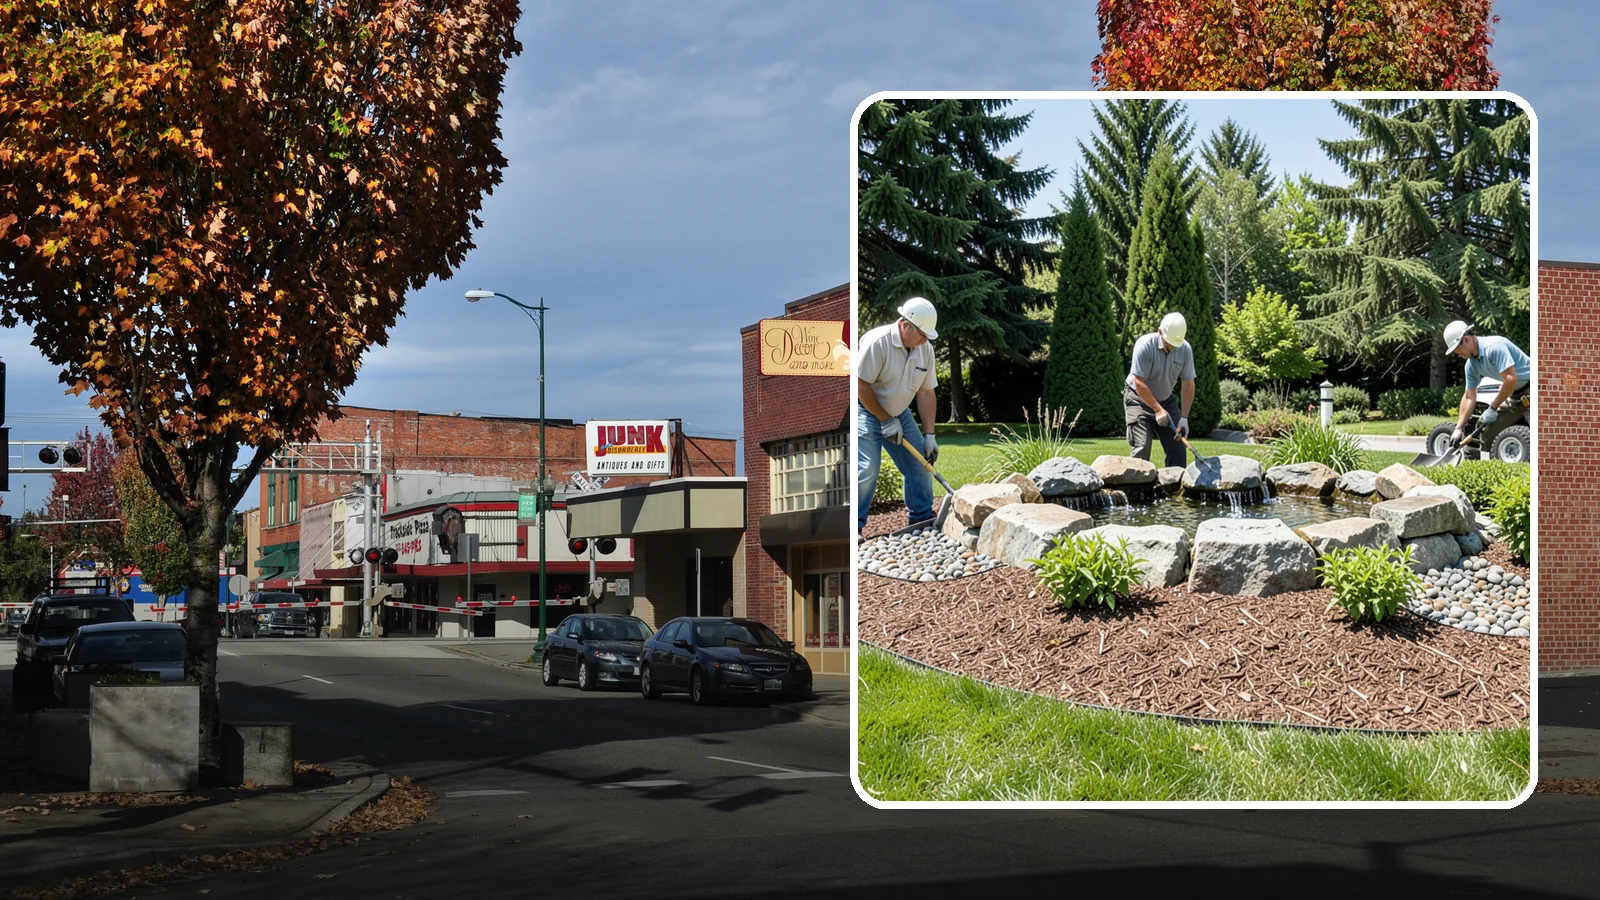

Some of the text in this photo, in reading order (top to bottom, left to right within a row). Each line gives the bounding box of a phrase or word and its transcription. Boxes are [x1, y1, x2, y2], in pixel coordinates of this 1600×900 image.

[596, 425, 665, 457] JUNK
[608, 446, 645, 454] DISORDERLY
[597, 460, 665, 470] ANTIQUES AND GIFTS
[390, 519, 429, 540] Trackside Pizza
